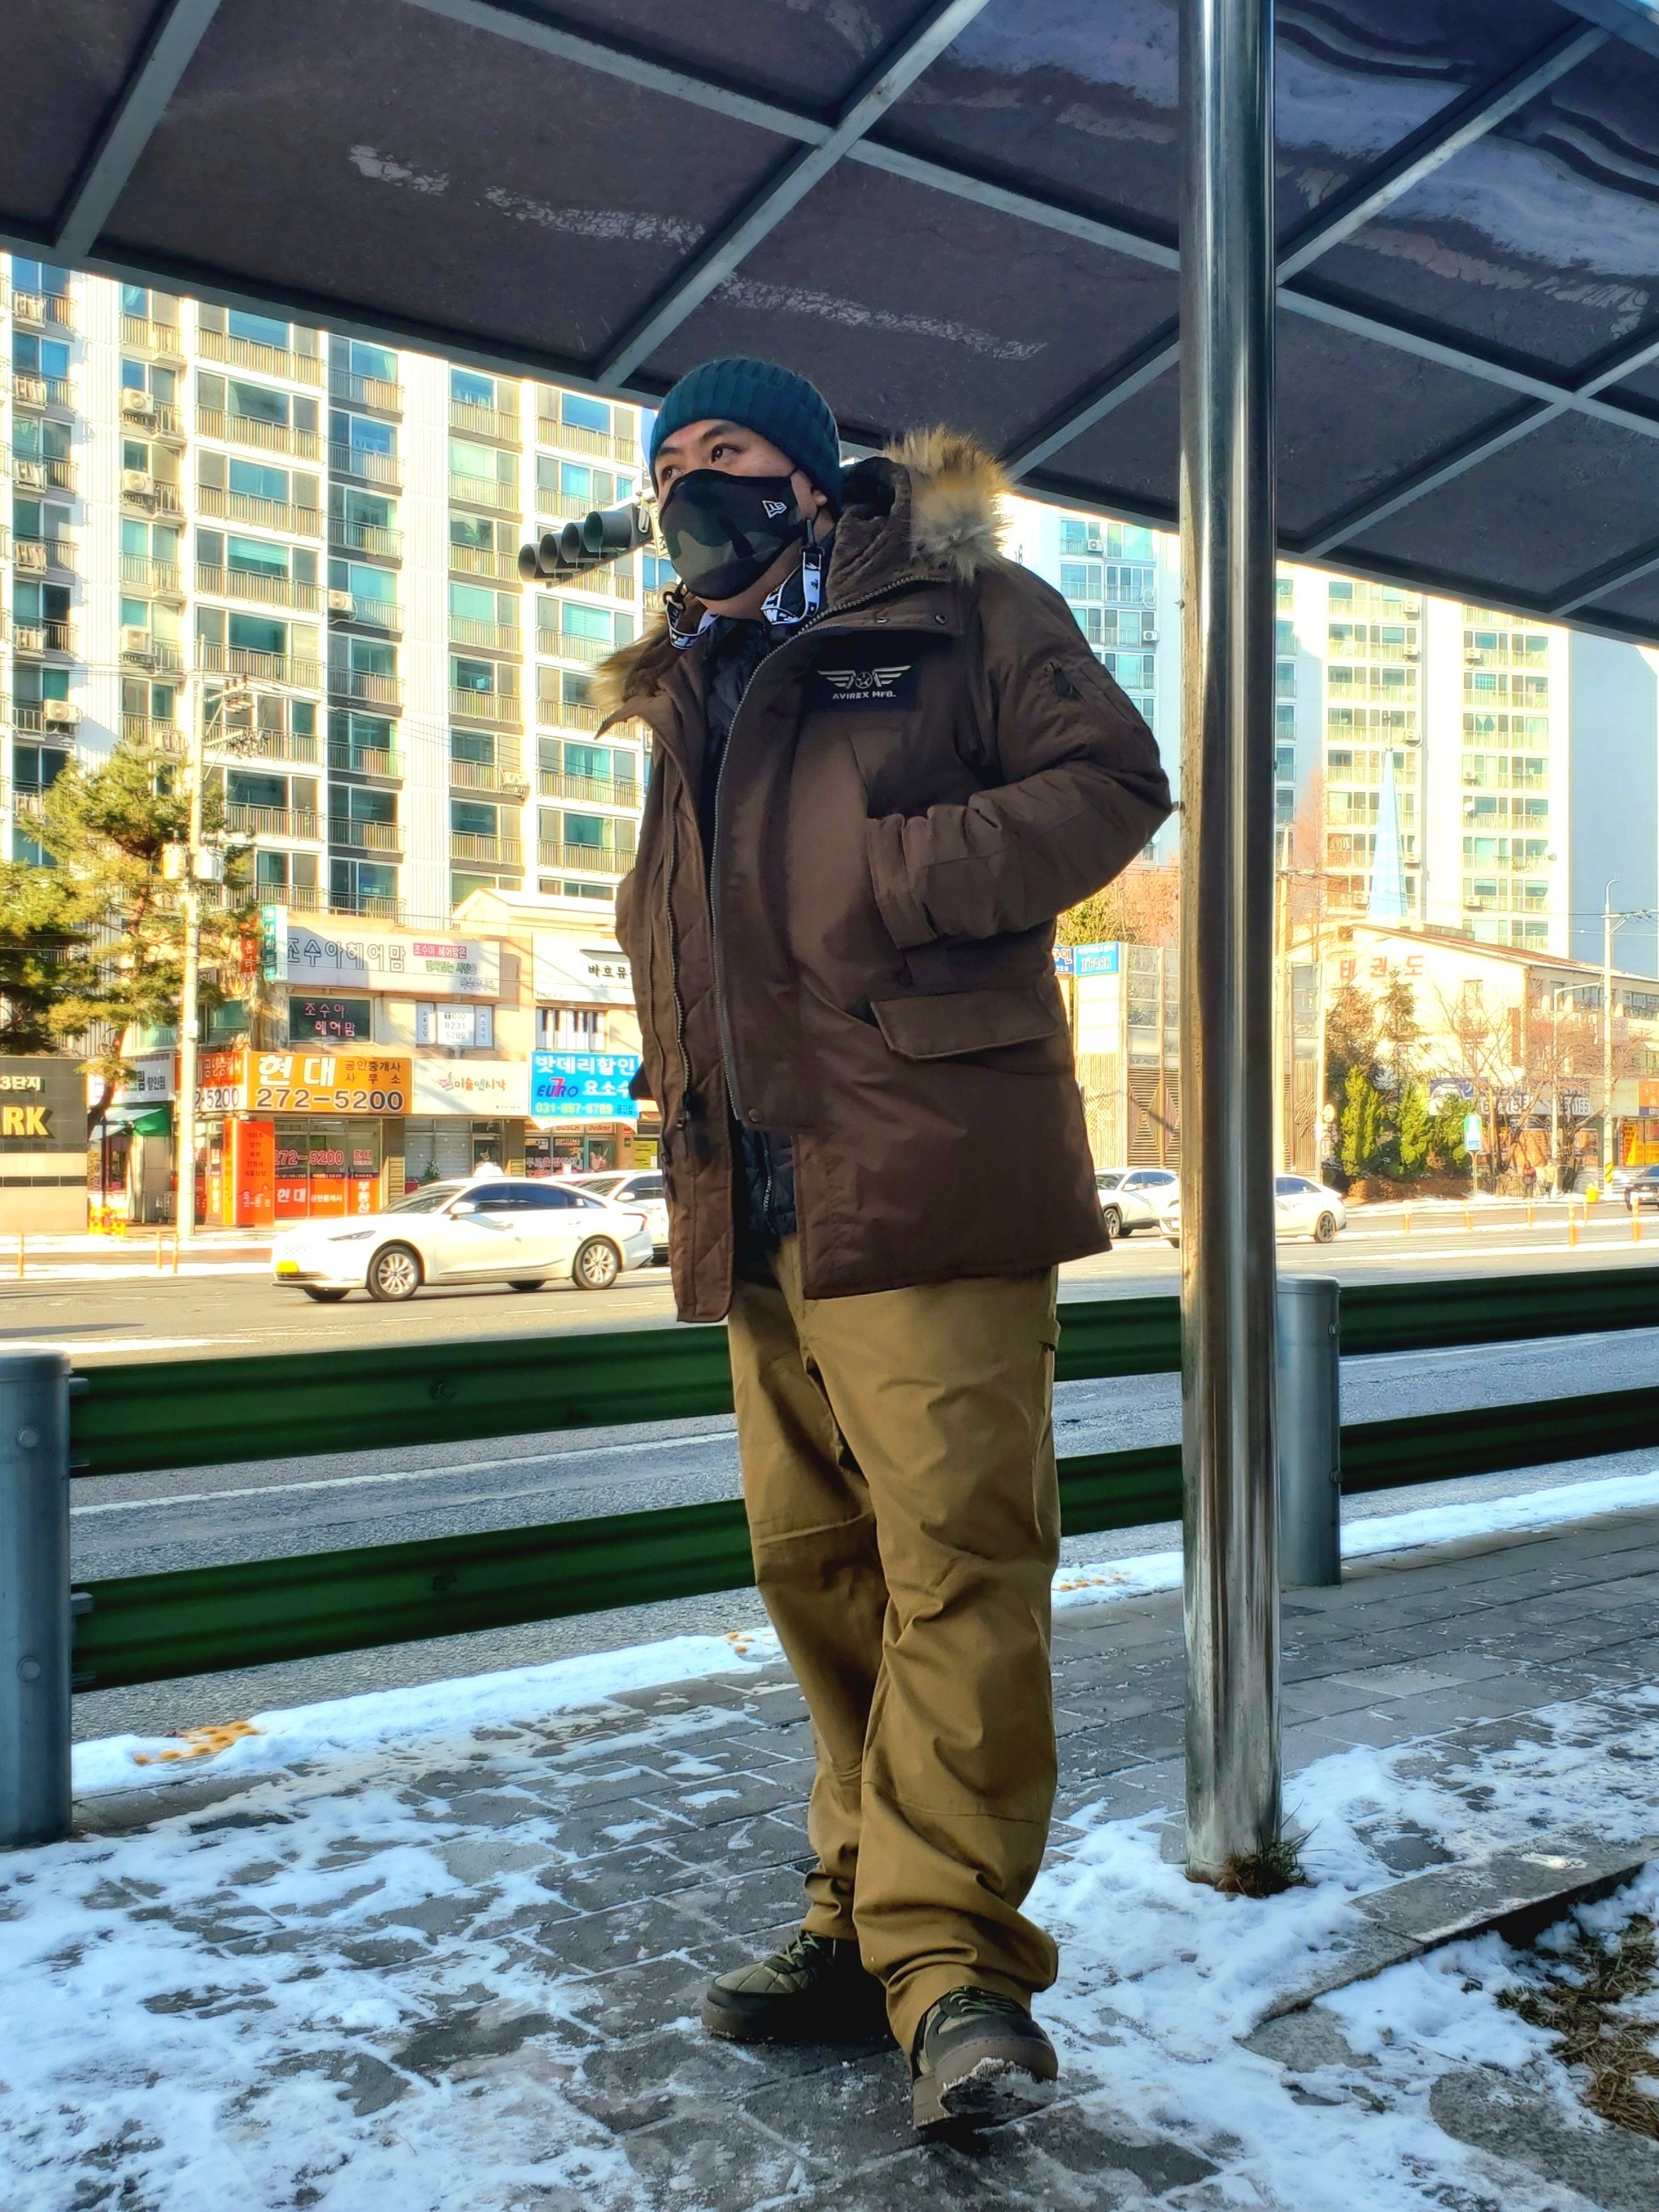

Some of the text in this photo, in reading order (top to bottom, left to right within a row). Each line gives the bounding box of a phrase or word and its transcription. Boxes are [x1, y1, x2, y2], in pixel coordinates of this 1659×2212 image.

[833, 691, 869, 699] AVIREX
[287, 938, 406, 973] 조수아헤어맘
[588, 964, 632, 979] 바흐뮤
[304, 1002, 345, 1019] 조수아
[315, 1020, 356, 1037] 헤어맘
[444, 1021, 466, 1030] 8231
[258, 1054, 402, 1087] 현대 공인중개사
[535, 1055, 635, 1077] 밧데리할인
[0, 1075, 41, 1091] 3단지
[147, 1076, 166, 1091] 할인점
[256, 1088, 403, 1111] 272-5200
[0, 1106, 49, 1135] RK
[274, 1149, 344, 1166] 272-5200
[276, 1187, 307, 1203] 현대
